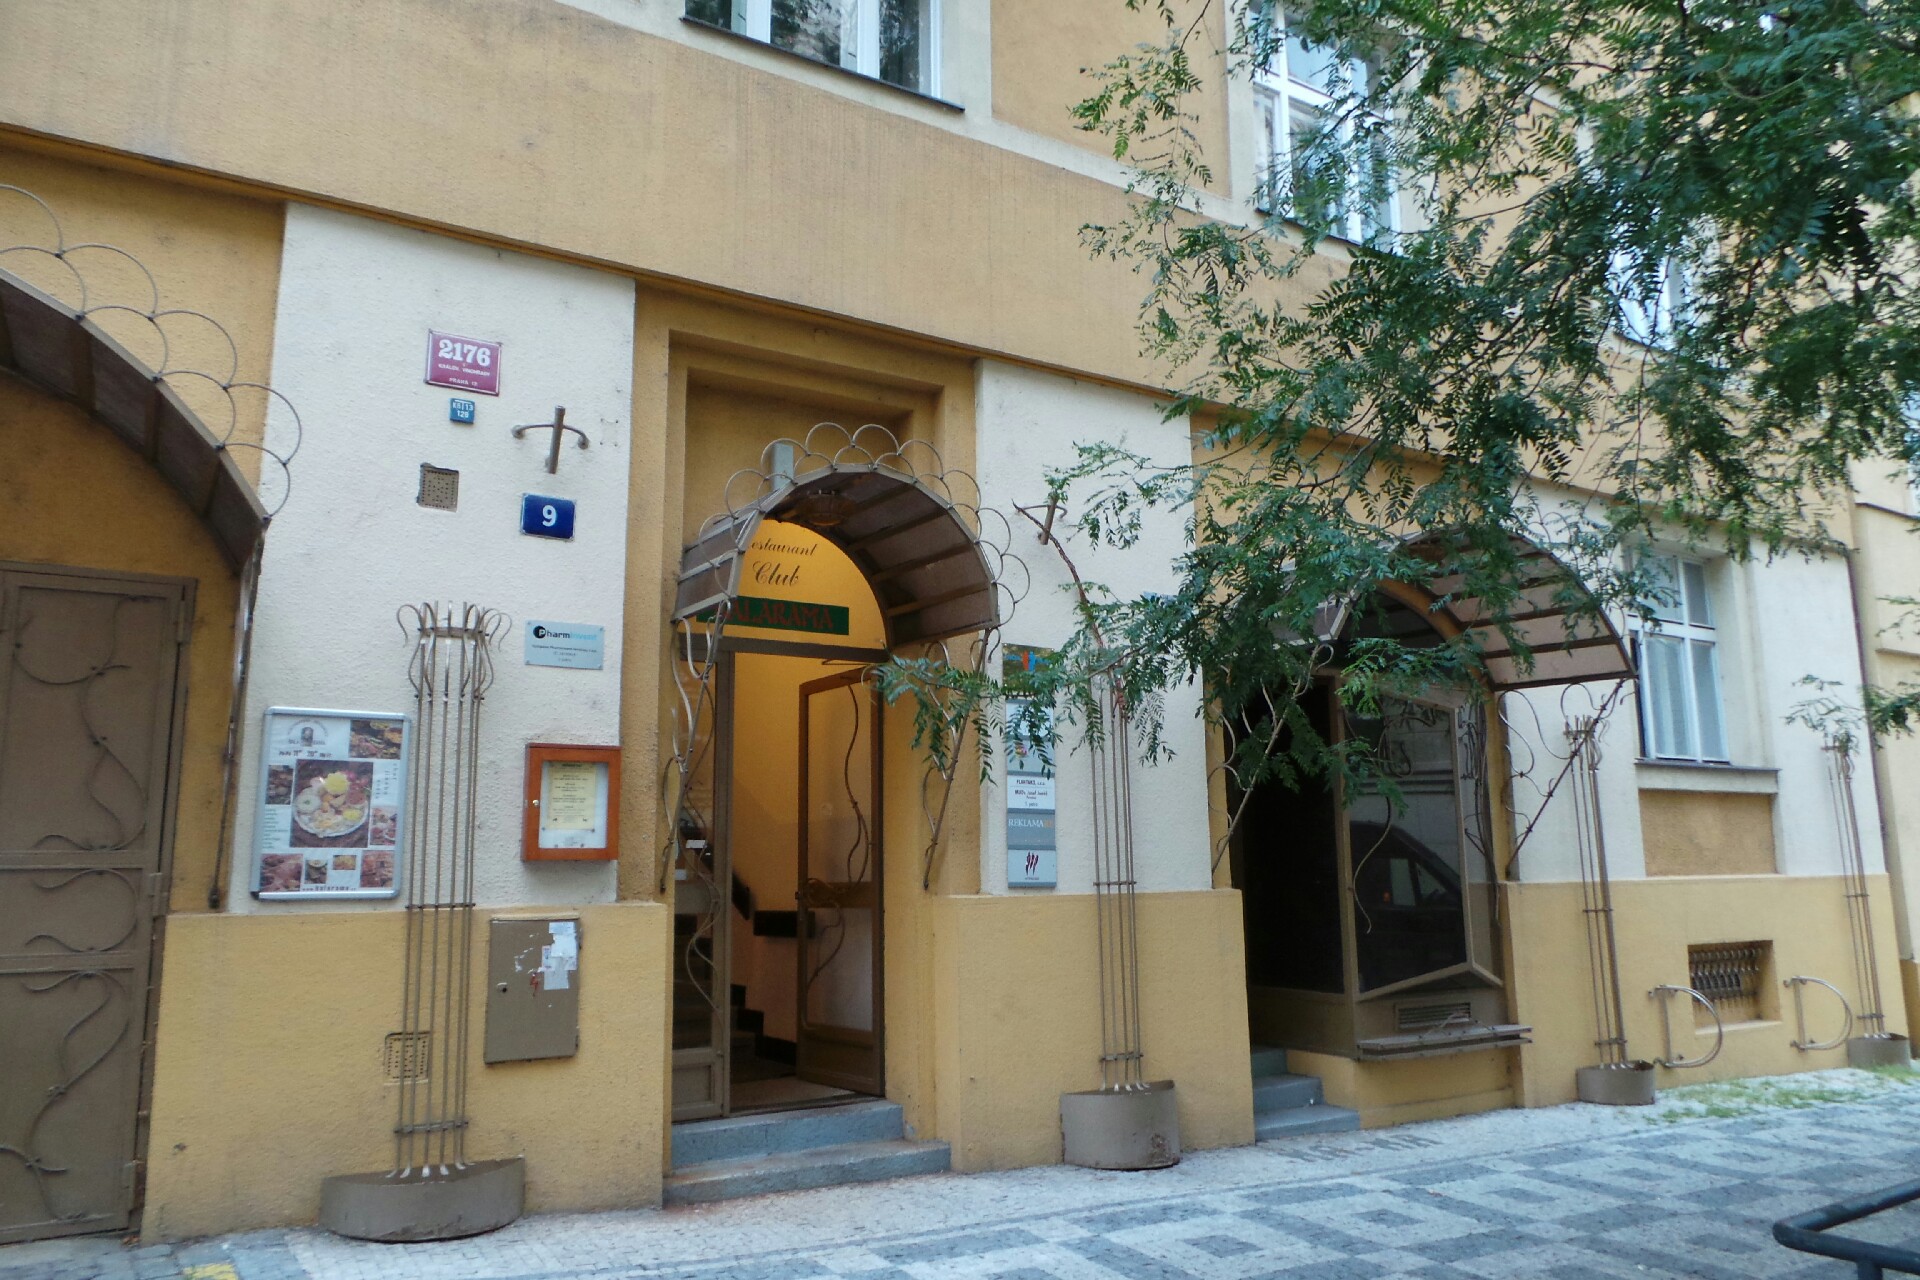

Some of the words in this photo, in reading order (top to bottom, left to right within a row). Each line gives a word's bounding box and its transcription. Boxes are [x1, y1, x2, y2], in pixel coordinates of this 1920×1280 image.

[438, 339, 491, 367] 2176
[449, 377, 469, 385] PRAHA
[542, 504, 557, 527] 9
[751, 538, 817, 556] estaurant
[752, 560, 800, 587] Club
